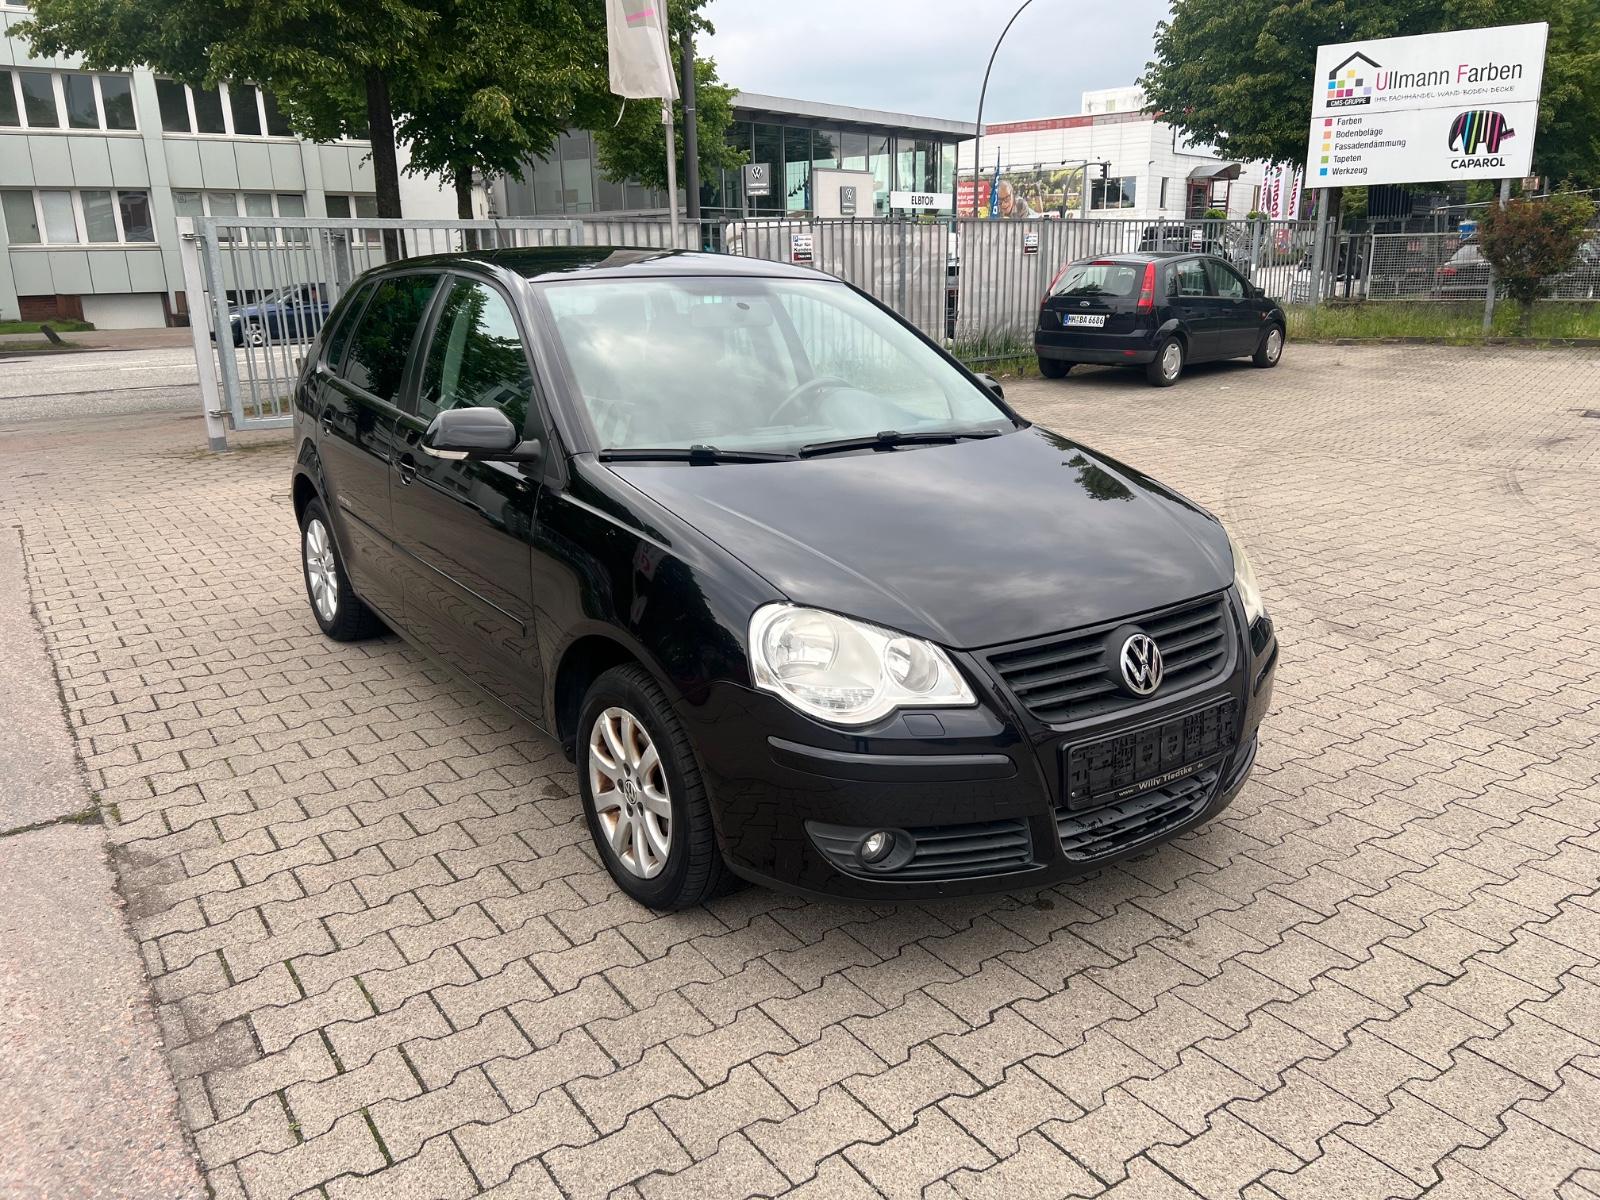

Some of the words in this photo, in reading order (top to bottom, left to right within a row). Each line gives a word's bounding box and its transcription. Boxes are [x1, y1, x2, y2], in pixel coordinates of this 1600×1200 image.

[1376, 69, 1450, 91] Ullmann
[1456, 61, 1522, 83] Farben
[1330, 97, 1367, 107] CMS-GRUPPE
[1336, 117, 1362, 126] Farben
[1335, 128, 1383, 139] Bodenbeläge
[1334, 139, 1406, 151] Fassadendämmung
[1333, 154, 1362, 164] Tapeten
[1450, 157, 1506, 169] CAPAROL
[1332, 166, 1368, 176] Werkzeug
[911, 195, 934, 206] ELBTOR
[1138, 778, 1161, 790] Willy
